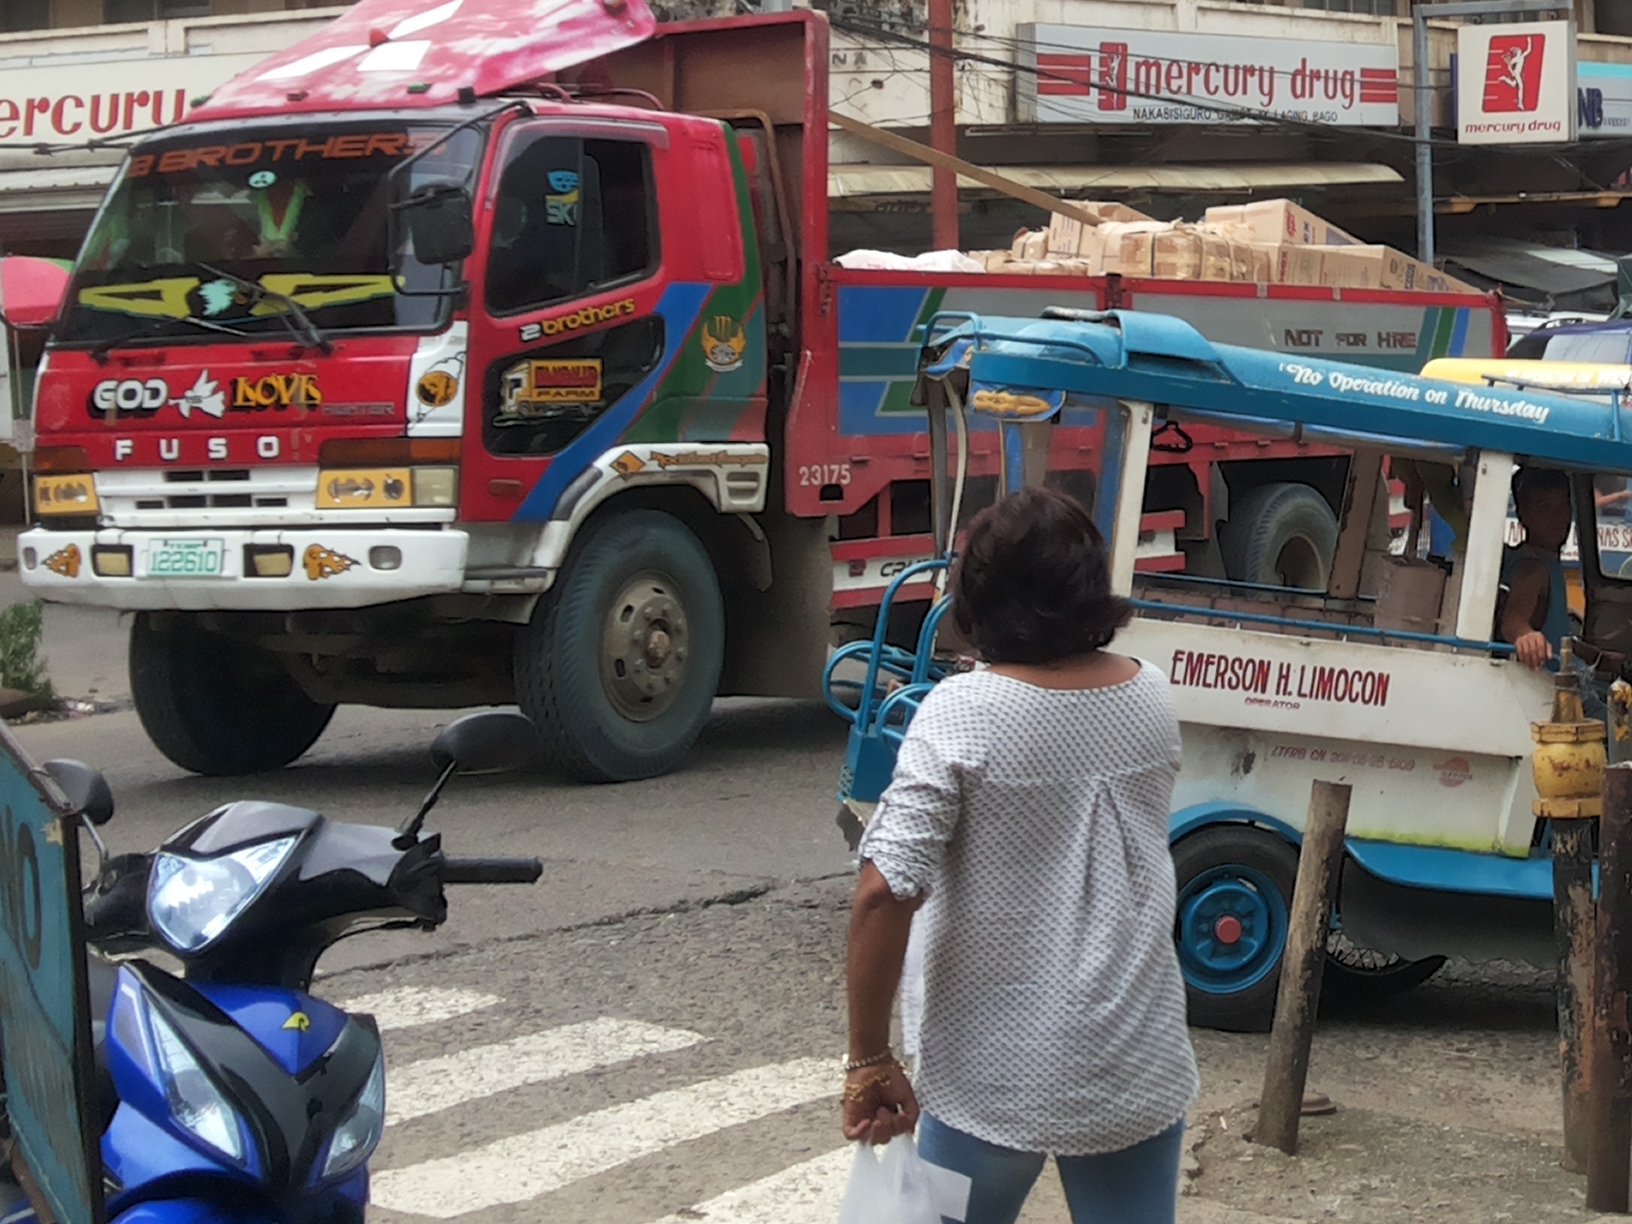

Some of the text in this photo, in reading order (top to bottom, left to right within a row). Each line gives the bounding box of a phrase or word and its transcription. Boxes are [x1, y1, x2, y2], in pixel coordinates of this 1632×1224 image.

[1134, 57, 1355, 110] mercury drug
[0, 89, 186, 138] ercury
[1465, 119, 1561, 133] mercury drug
[157, 131, 447, 174] BROTHERS
[542, 298, 636, 335] brothers
[1284, 329, 1417, 349] NOT FOR HIRE
[94, 378, 168, 410] GOD
[536, 390, 596, 398] FARM
[1329, 370, 1420, 401] Operation
[1425, 389, 1449, 406] on
[1455, 388, 1550, 425] Thursday
[115, 435, 280, 461] FUSO
[799, 463, 851, 487] 23175
[1170, 649, 1391, 707] EMERSON H. LIMOCON
[1244, 696, 1302, 711] OPERATOR
